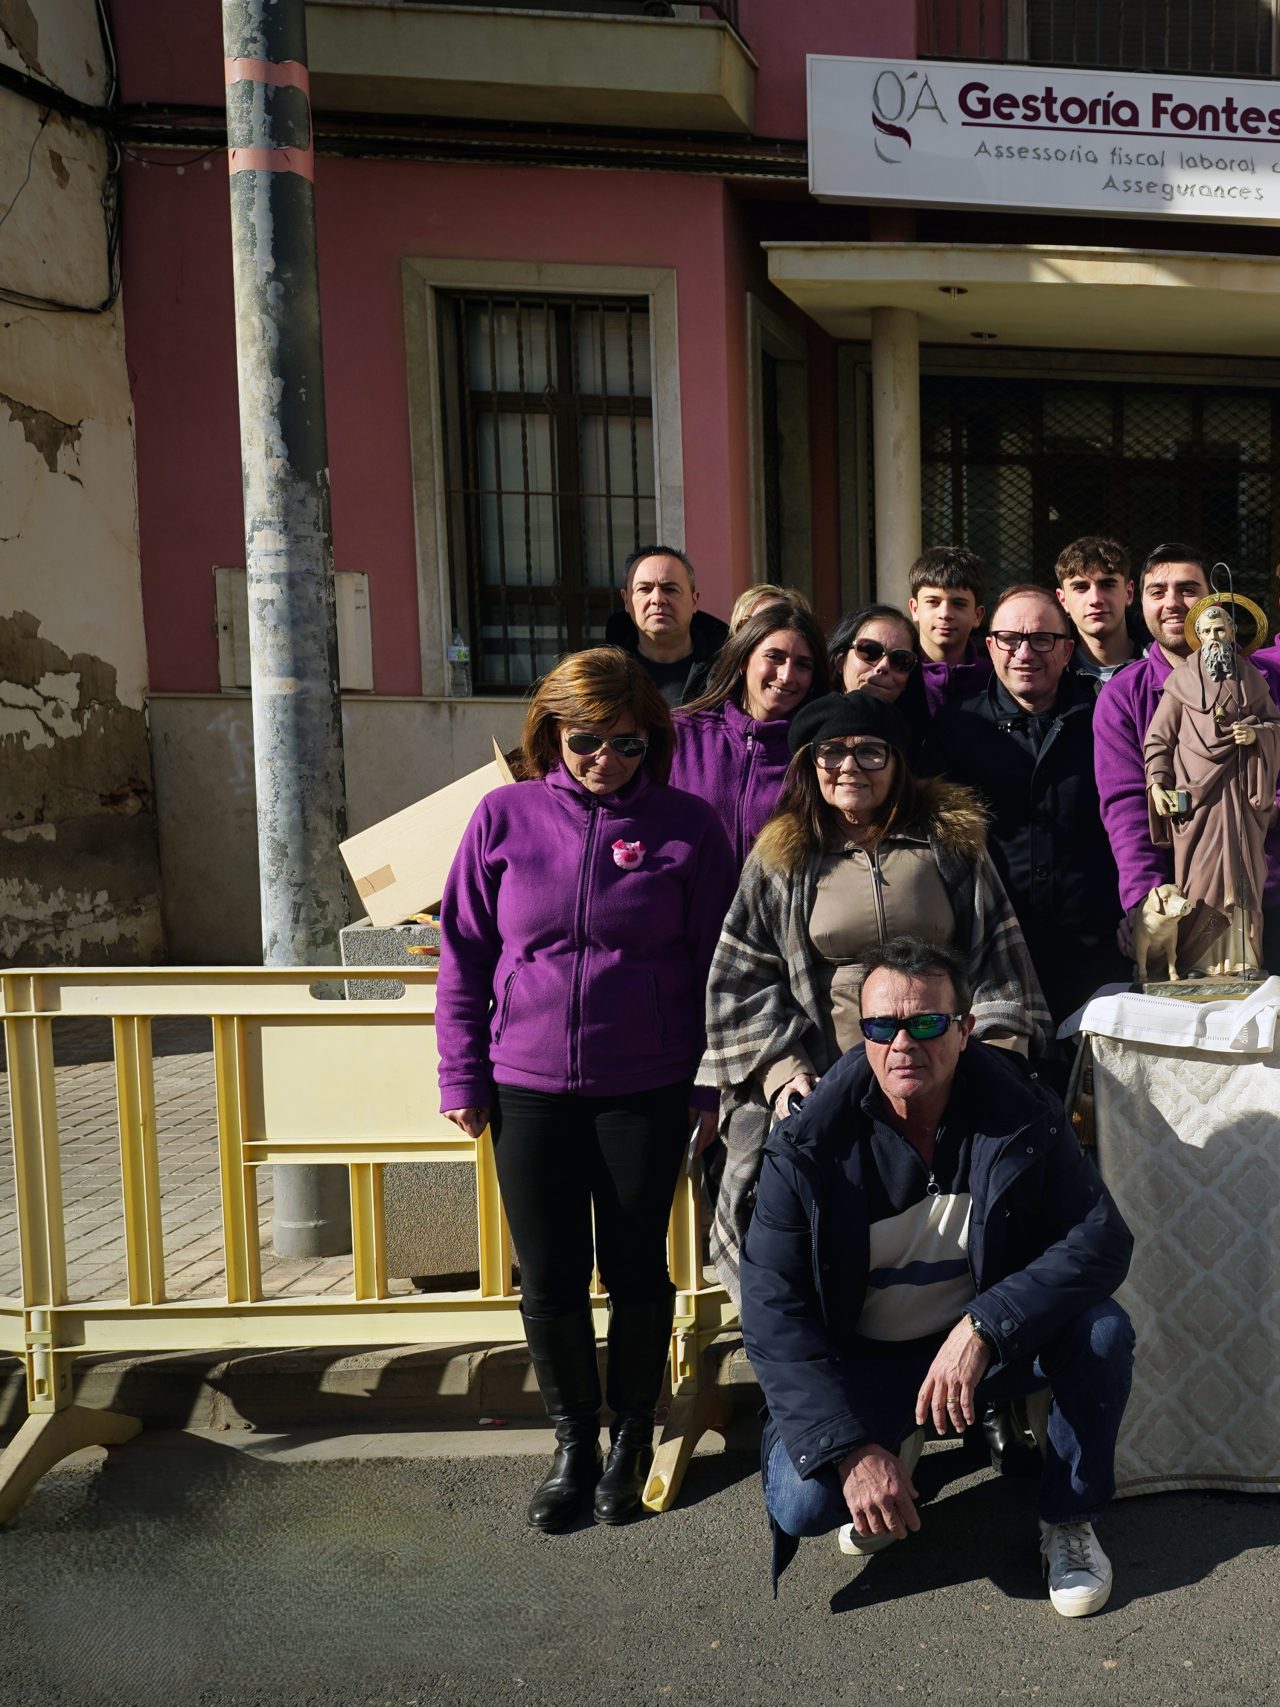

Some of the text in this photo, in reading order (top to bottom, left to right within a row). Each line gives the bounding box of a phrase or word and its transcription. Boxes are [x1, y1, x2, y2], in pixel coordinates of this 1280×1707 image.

[958, 81, 1140, 128] Gestoría
[974, 140, 1099, 164] Assessoria
[1110, 146, 1166, 167] fiscal
[1179, 151, 1256, 174] laboral
[1102, 174, 1264, 202] Assegurances
